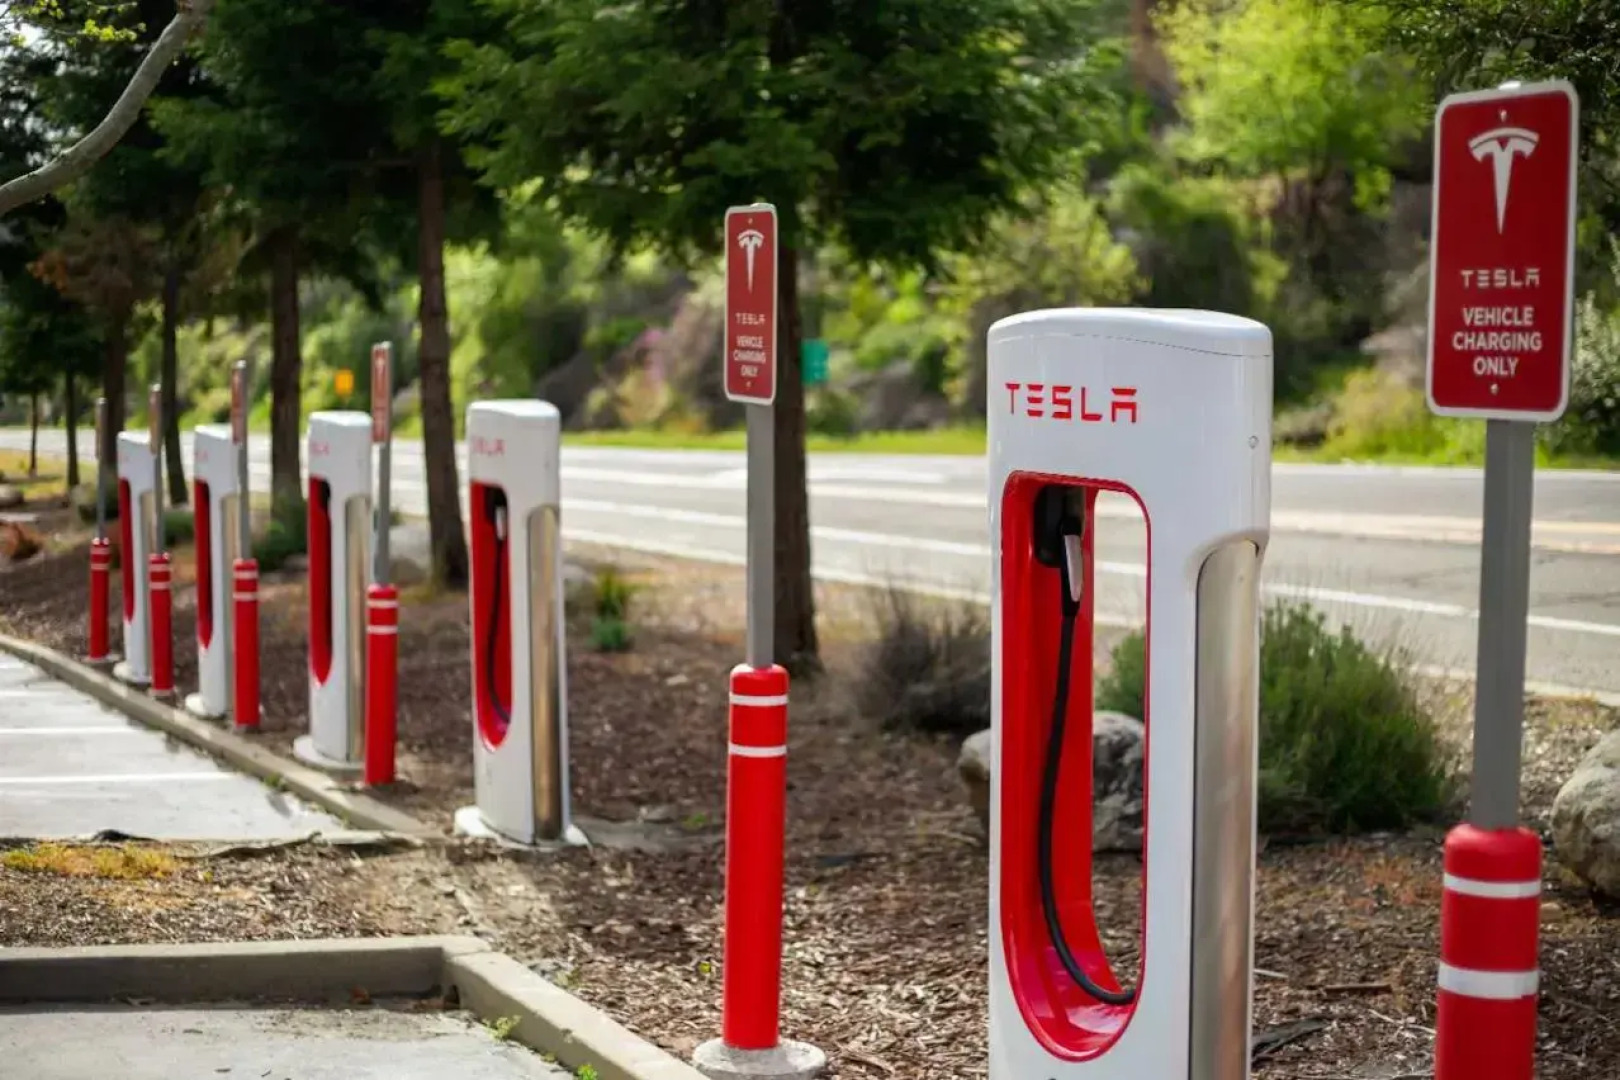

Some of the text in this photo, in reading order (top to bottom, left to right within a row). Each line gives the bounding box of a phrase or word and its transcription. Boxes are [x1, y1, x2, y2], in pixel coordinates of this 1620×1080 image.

[1461, 267, 1540, 288] TESLA
[735, 312, 766, 325] TESLA
[1463, 306, 1534, 326] VEHICLE
[736, 336, 763, 349] VEHICLE
[1453, 331, 1542, 352] CHARGING
[740, 365, 758, 377] ONLY
[1473, 356, 1519, 376] ONLY
[1005, 383, 1137, 422] TESLA
